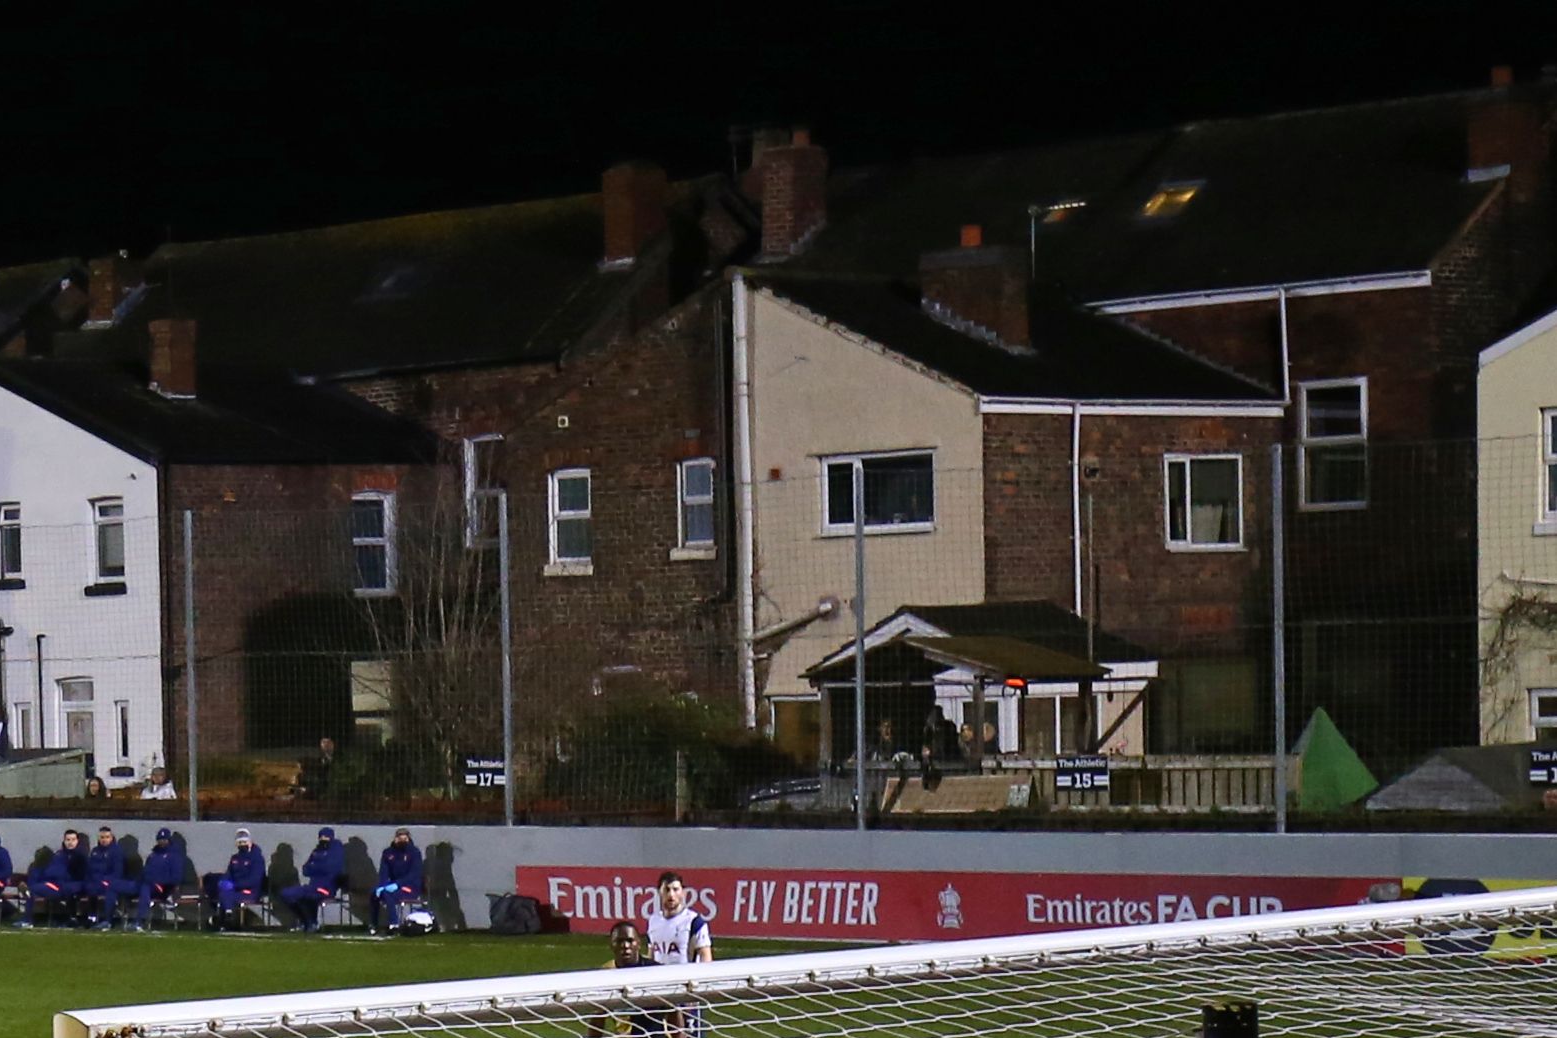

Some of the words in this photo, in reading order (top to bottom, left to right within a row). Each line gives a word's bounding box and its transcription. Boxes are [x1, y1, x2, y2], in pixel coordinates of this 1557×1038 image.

[466, 759, 479, 768] The
[1058, 758, 1074, 768] The
[1074, 758, 1106, 768] Athletic
[479, 773, 492, 787] 17
[1074, 772, 1092, 789] 15
[547, 876, 718, 921] Emiraes
[733, 880, 777, 923] FLY
[783, 880, 880, 925] BETTER
[1025, 893, 1152, 926] Emirates
[1156, 894, 1199, 924] FA
[652, 941, 681, 955] AIA
